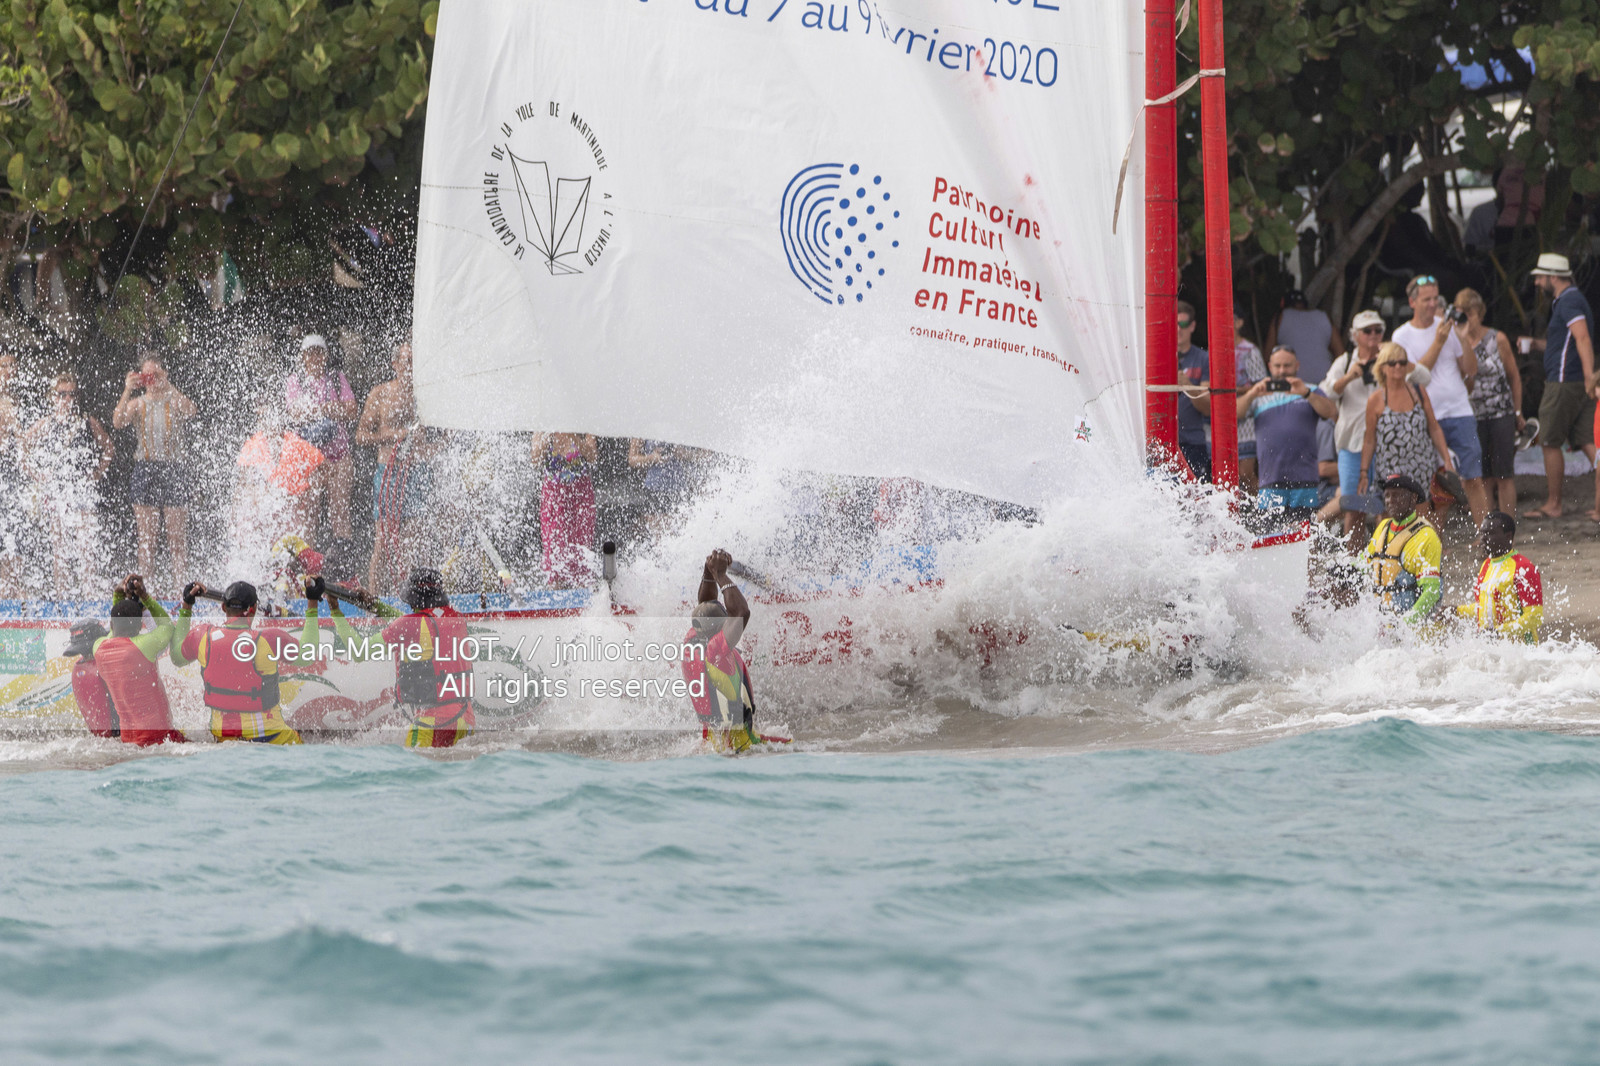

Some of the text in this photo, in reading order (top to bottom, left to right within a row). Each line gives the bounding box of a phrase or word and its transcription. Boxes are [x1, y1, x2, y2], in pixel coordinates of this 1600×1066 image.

[801, 1, 848, 32] au
[983, 37, 1058, 87] 2020
[515, 102, 535, 122] YOLE
[549, 101, 560, 118] DE
[501, 122, 513, 138] LA
[570, 112, 608, 172] MARTINIQUE
[491, 144, 505, 161] DE
[514, 243, 525, 260] LA
[914, 287, 1038, 328] en France
[909, 325, 970, 346] connaître,
[973, 334, 1028, 357] pratiquer,
